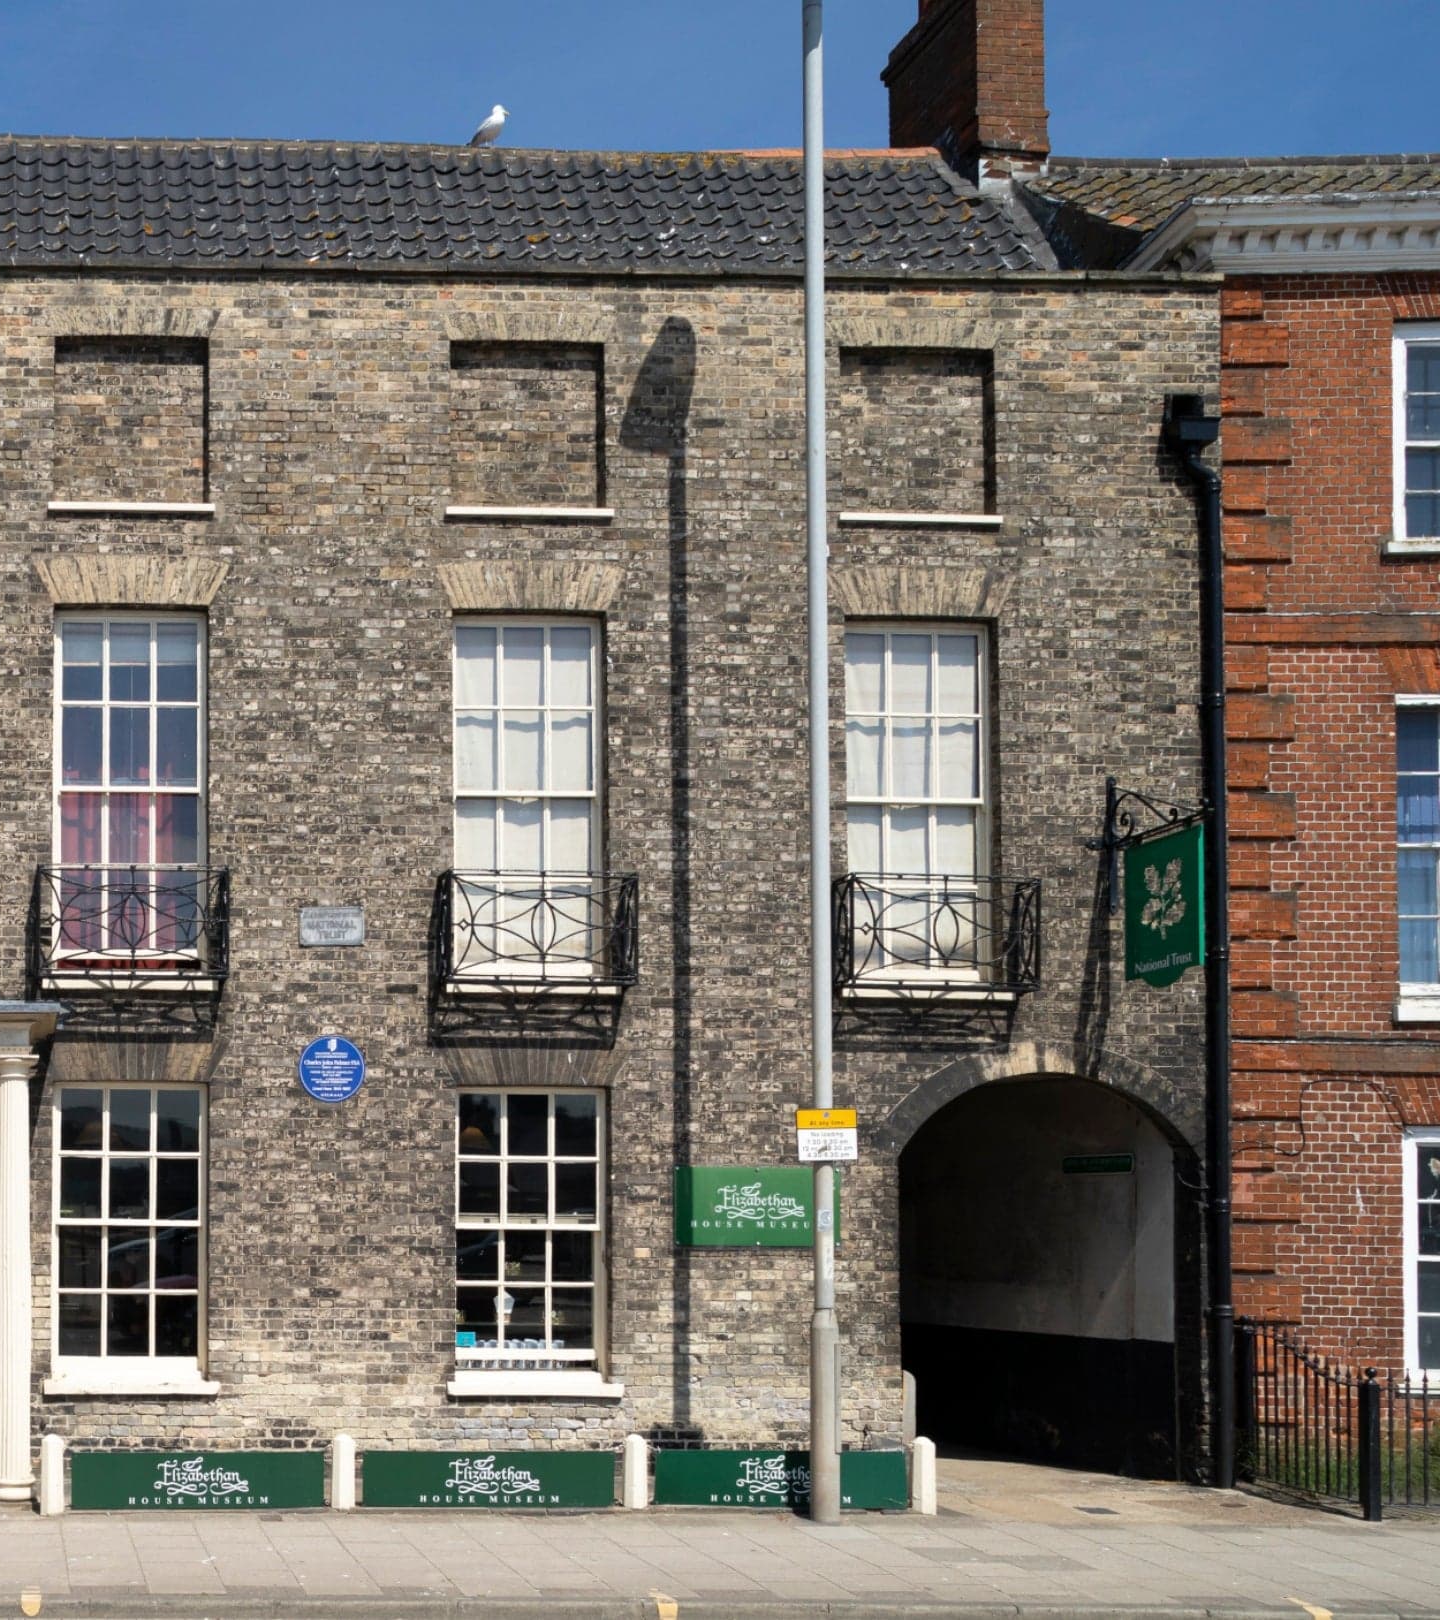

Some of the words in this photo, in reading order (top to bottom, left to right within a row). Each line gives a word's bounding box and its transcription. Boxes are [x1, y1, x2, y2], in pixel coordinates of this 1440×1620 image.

[1134, 953, 1169, 975] National
[1171, 952, 1192, 966] Trust
[714, 1182, 805, 1219] Elizabethan
[691, 1220, 743, 1229] HOUSE
[756, 1220, 810, 1229] MUSEU
[154, 1456, 249, 1495] Elizabethan
[445, 1455, 540, 1493] Elizabethan
[128, 1496, 185, 1505] HOUSE
[197, 1496, 269, 1505] MUSEUM
[419, 1495, 476, 1503] HOUSE
[489, 1495, 560, 1503] MUSEUM
[710, 1494, 767, 1502] HOUSE
